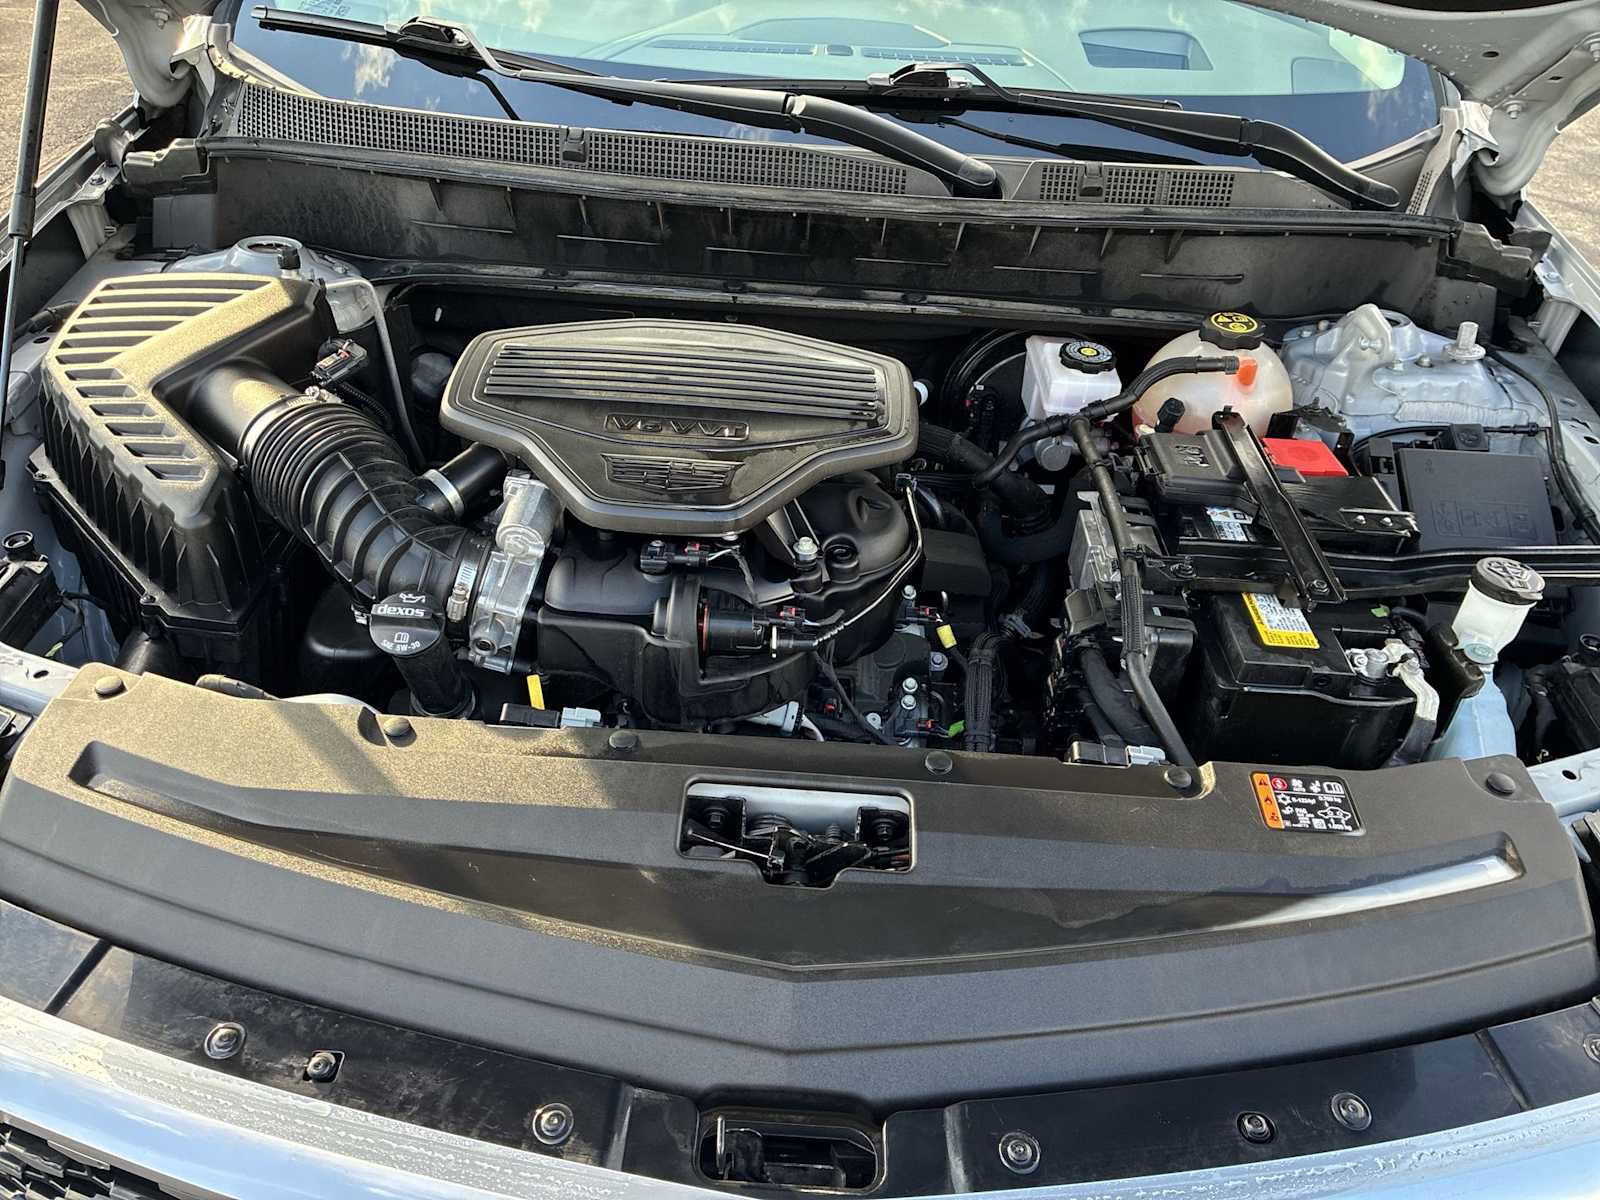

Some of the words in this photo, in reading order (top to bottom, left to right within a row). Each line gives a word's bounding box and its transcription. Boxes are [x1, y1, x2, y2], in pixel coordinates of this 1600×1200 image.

[612, 415, 663, 433] V6
[670, 420, 745, 438] VVT
[377, 604, 426, 617] dexos
[396, 641, 421, 652] 5W-30
